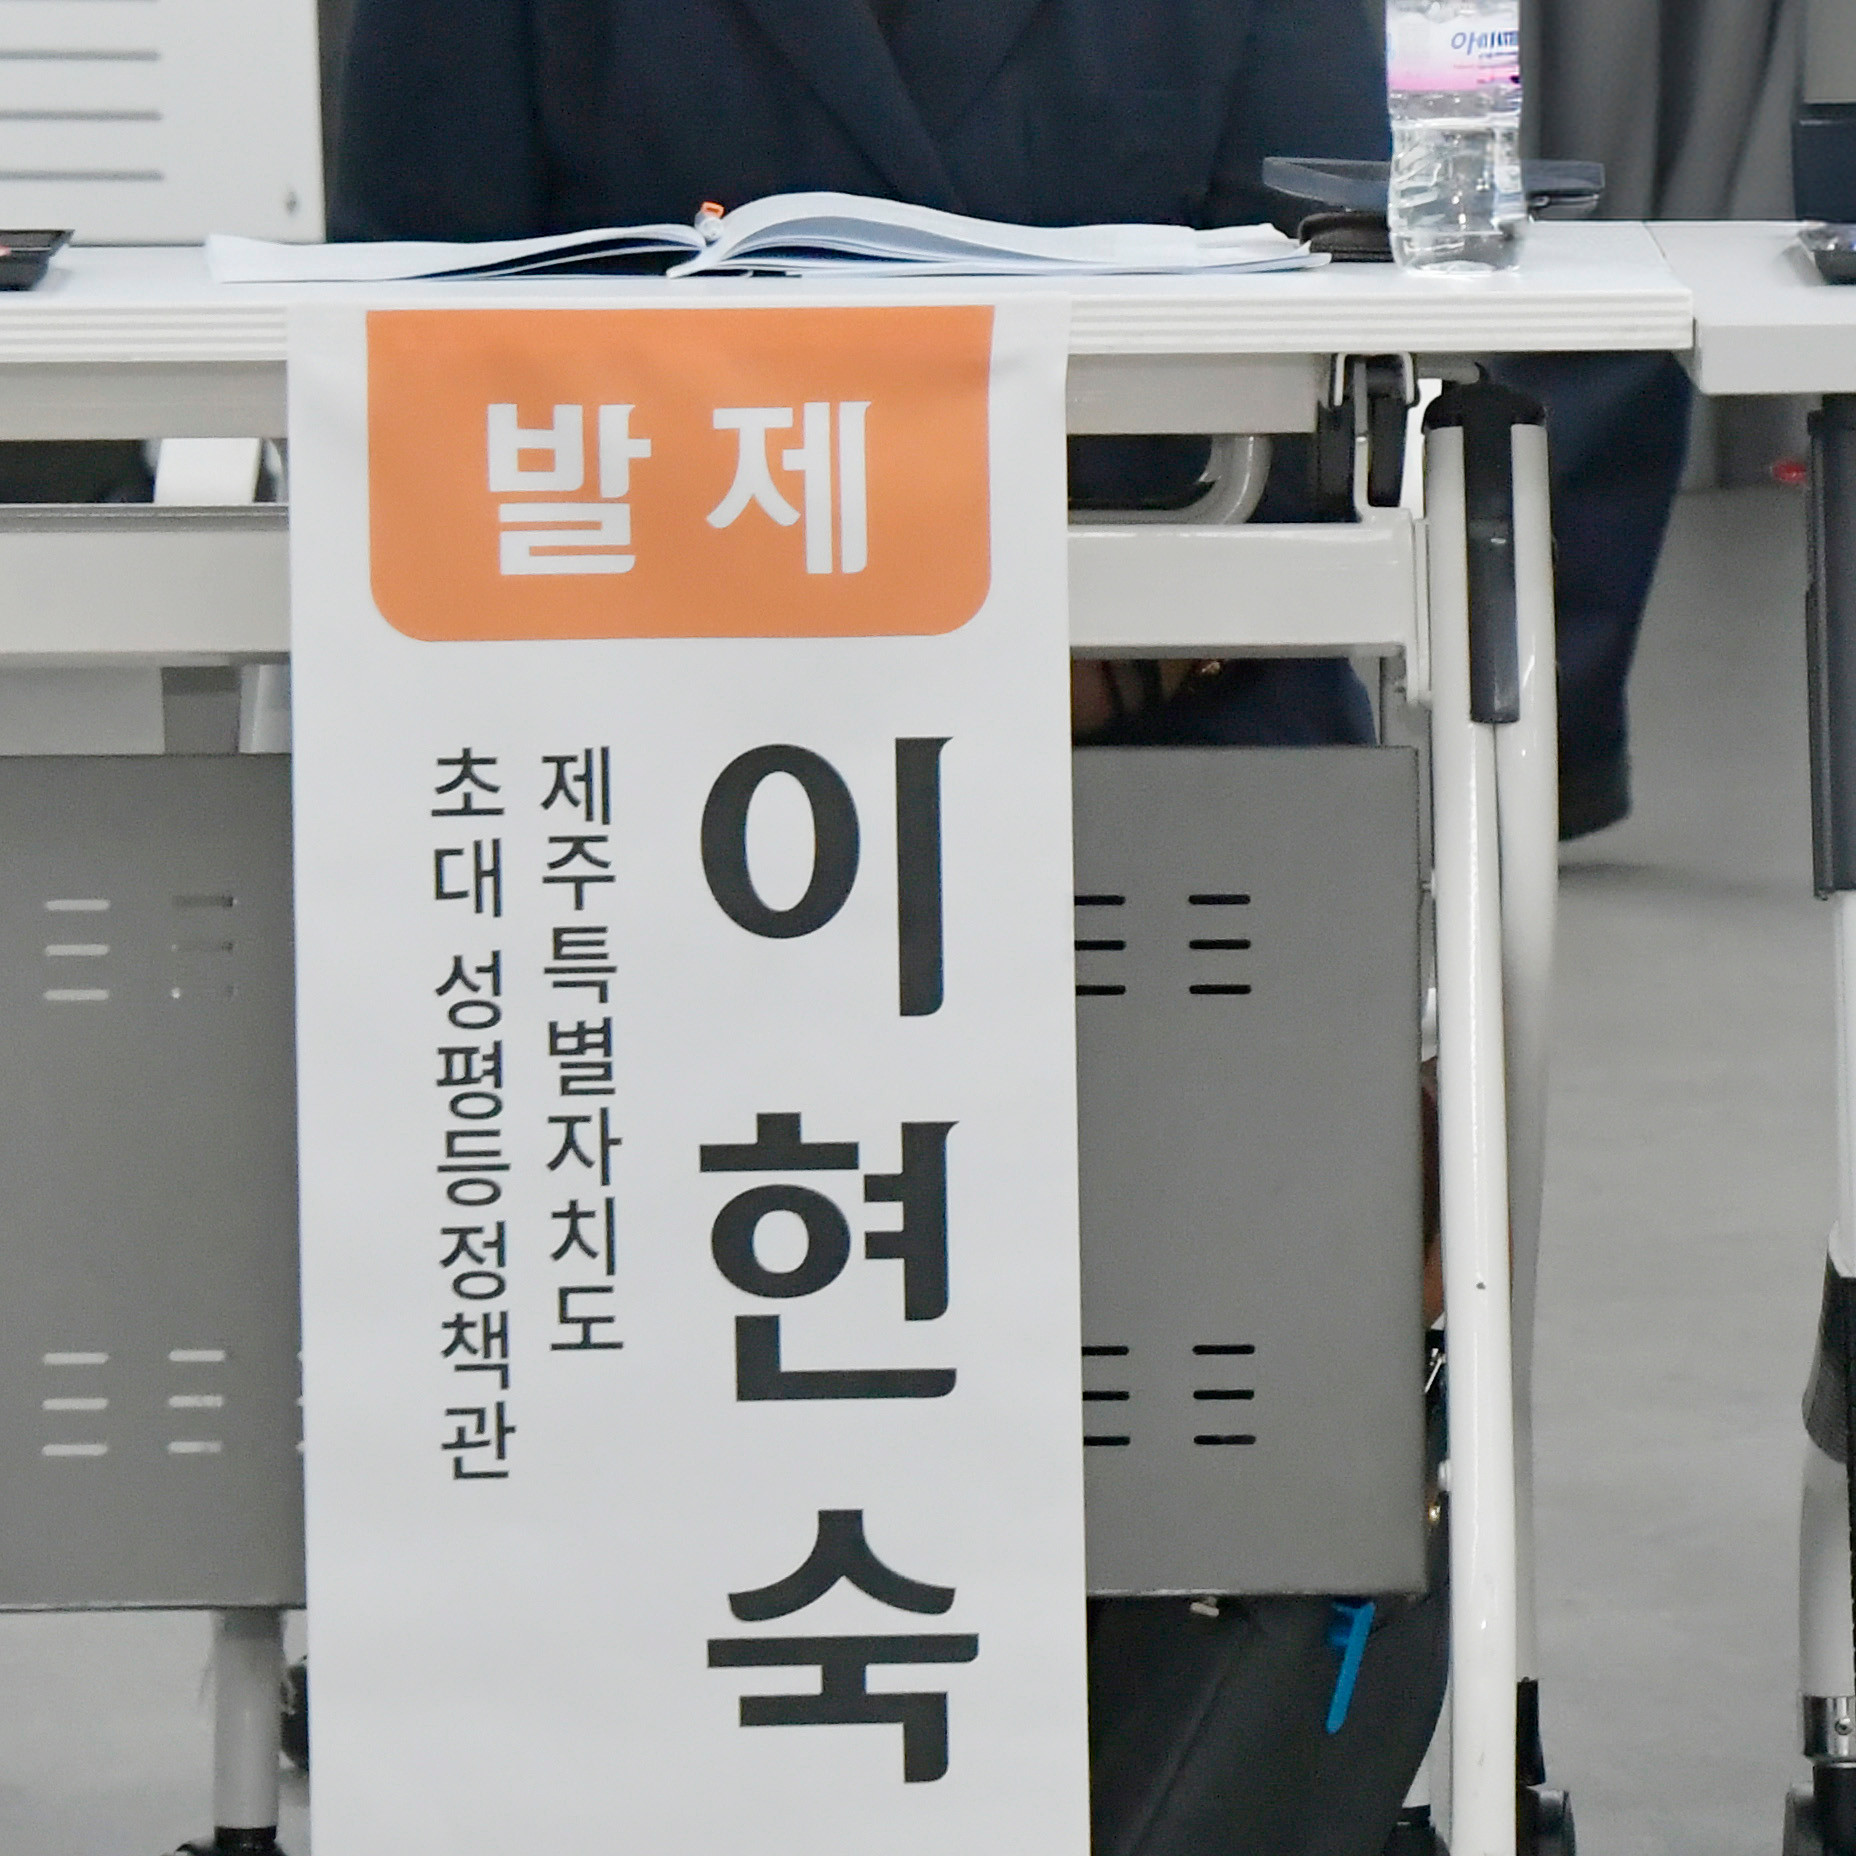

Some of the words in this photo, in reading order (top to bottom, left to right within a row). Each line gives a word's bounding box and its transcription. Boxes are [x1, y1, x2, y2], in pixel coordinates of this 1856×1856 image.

[487, 401, 872, 576] 발제
[431, 747, 505, 918] 초대
[540, 745, 624, 1351] 제주특별자치도
[435, 949, 516, 1480] 성평등정책관
[699, 736, 980, 1784] 이현숙
